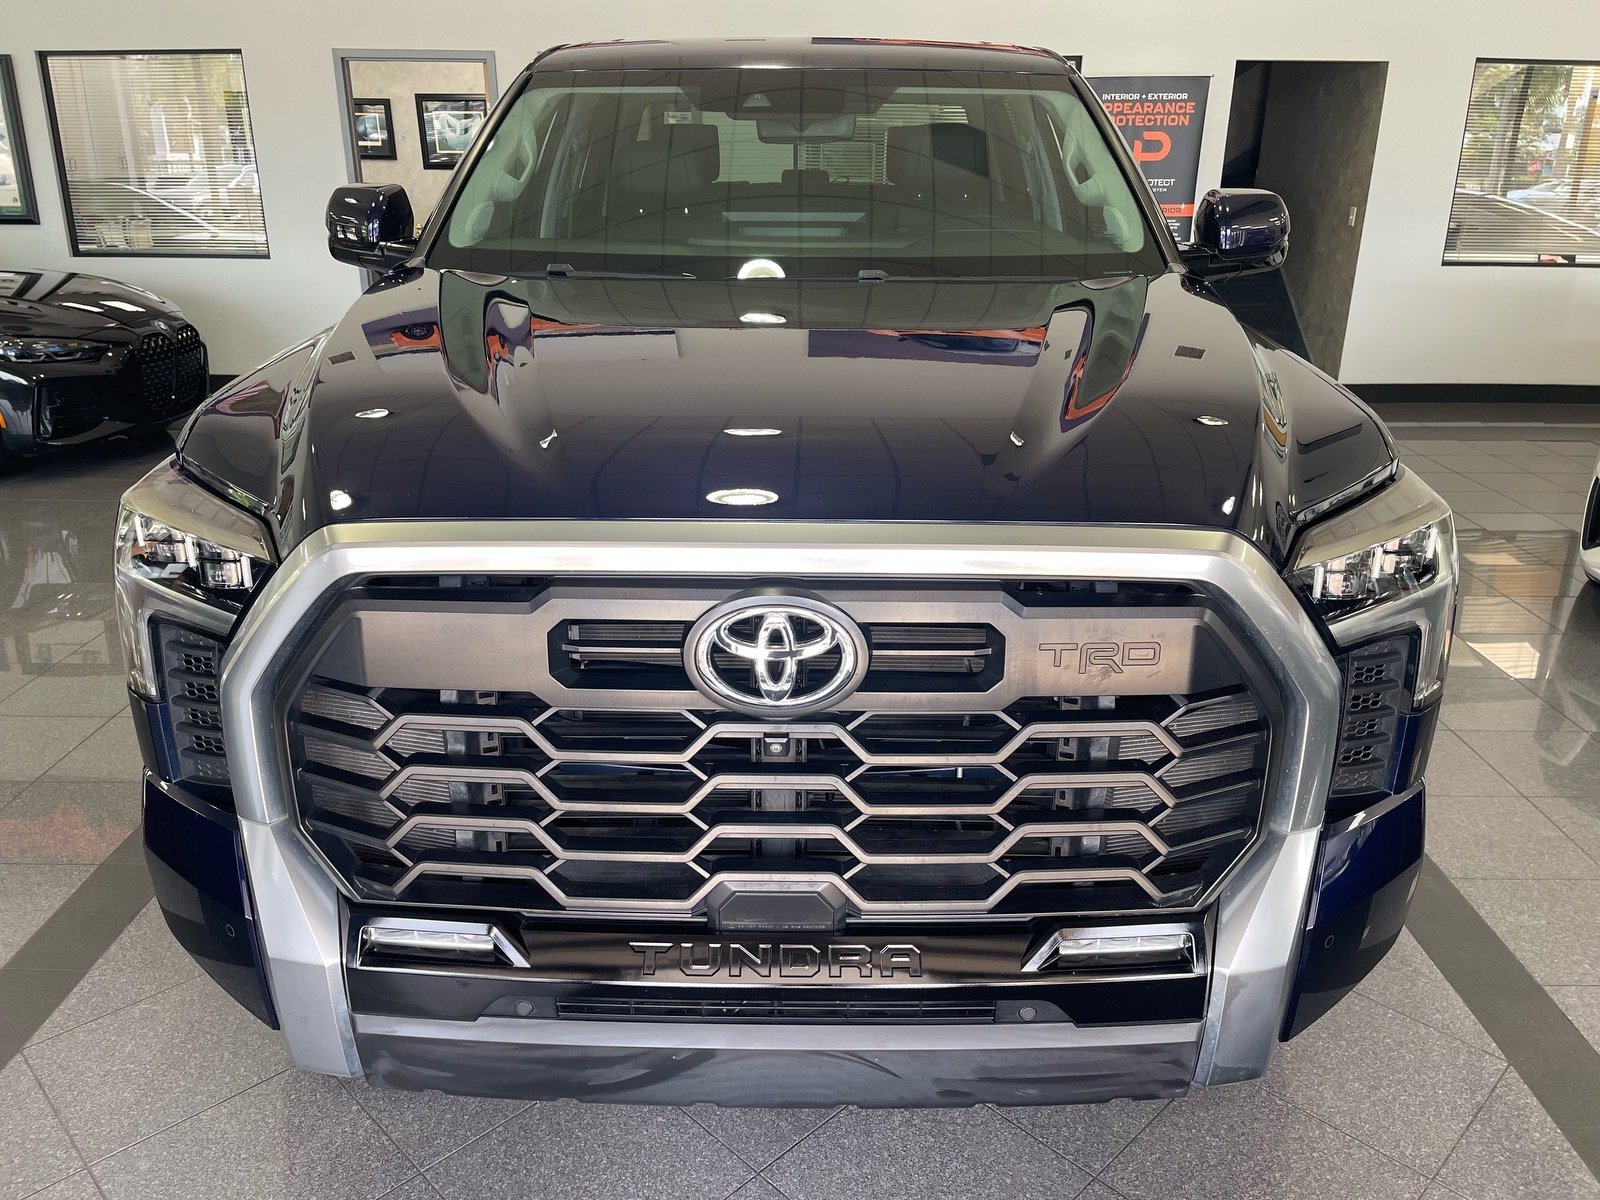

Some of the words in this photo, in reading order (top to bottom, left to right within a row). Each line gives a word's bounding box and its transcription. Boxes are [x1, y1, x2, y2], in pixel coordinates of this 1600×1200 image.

[1103, 102, 1196, 114] PPEARANCE
[1111, 114, 1190, 126] OTECTION
[1039, 641, 1161, 674] TRD
[628, 942, 922, 977] TUNDRA
